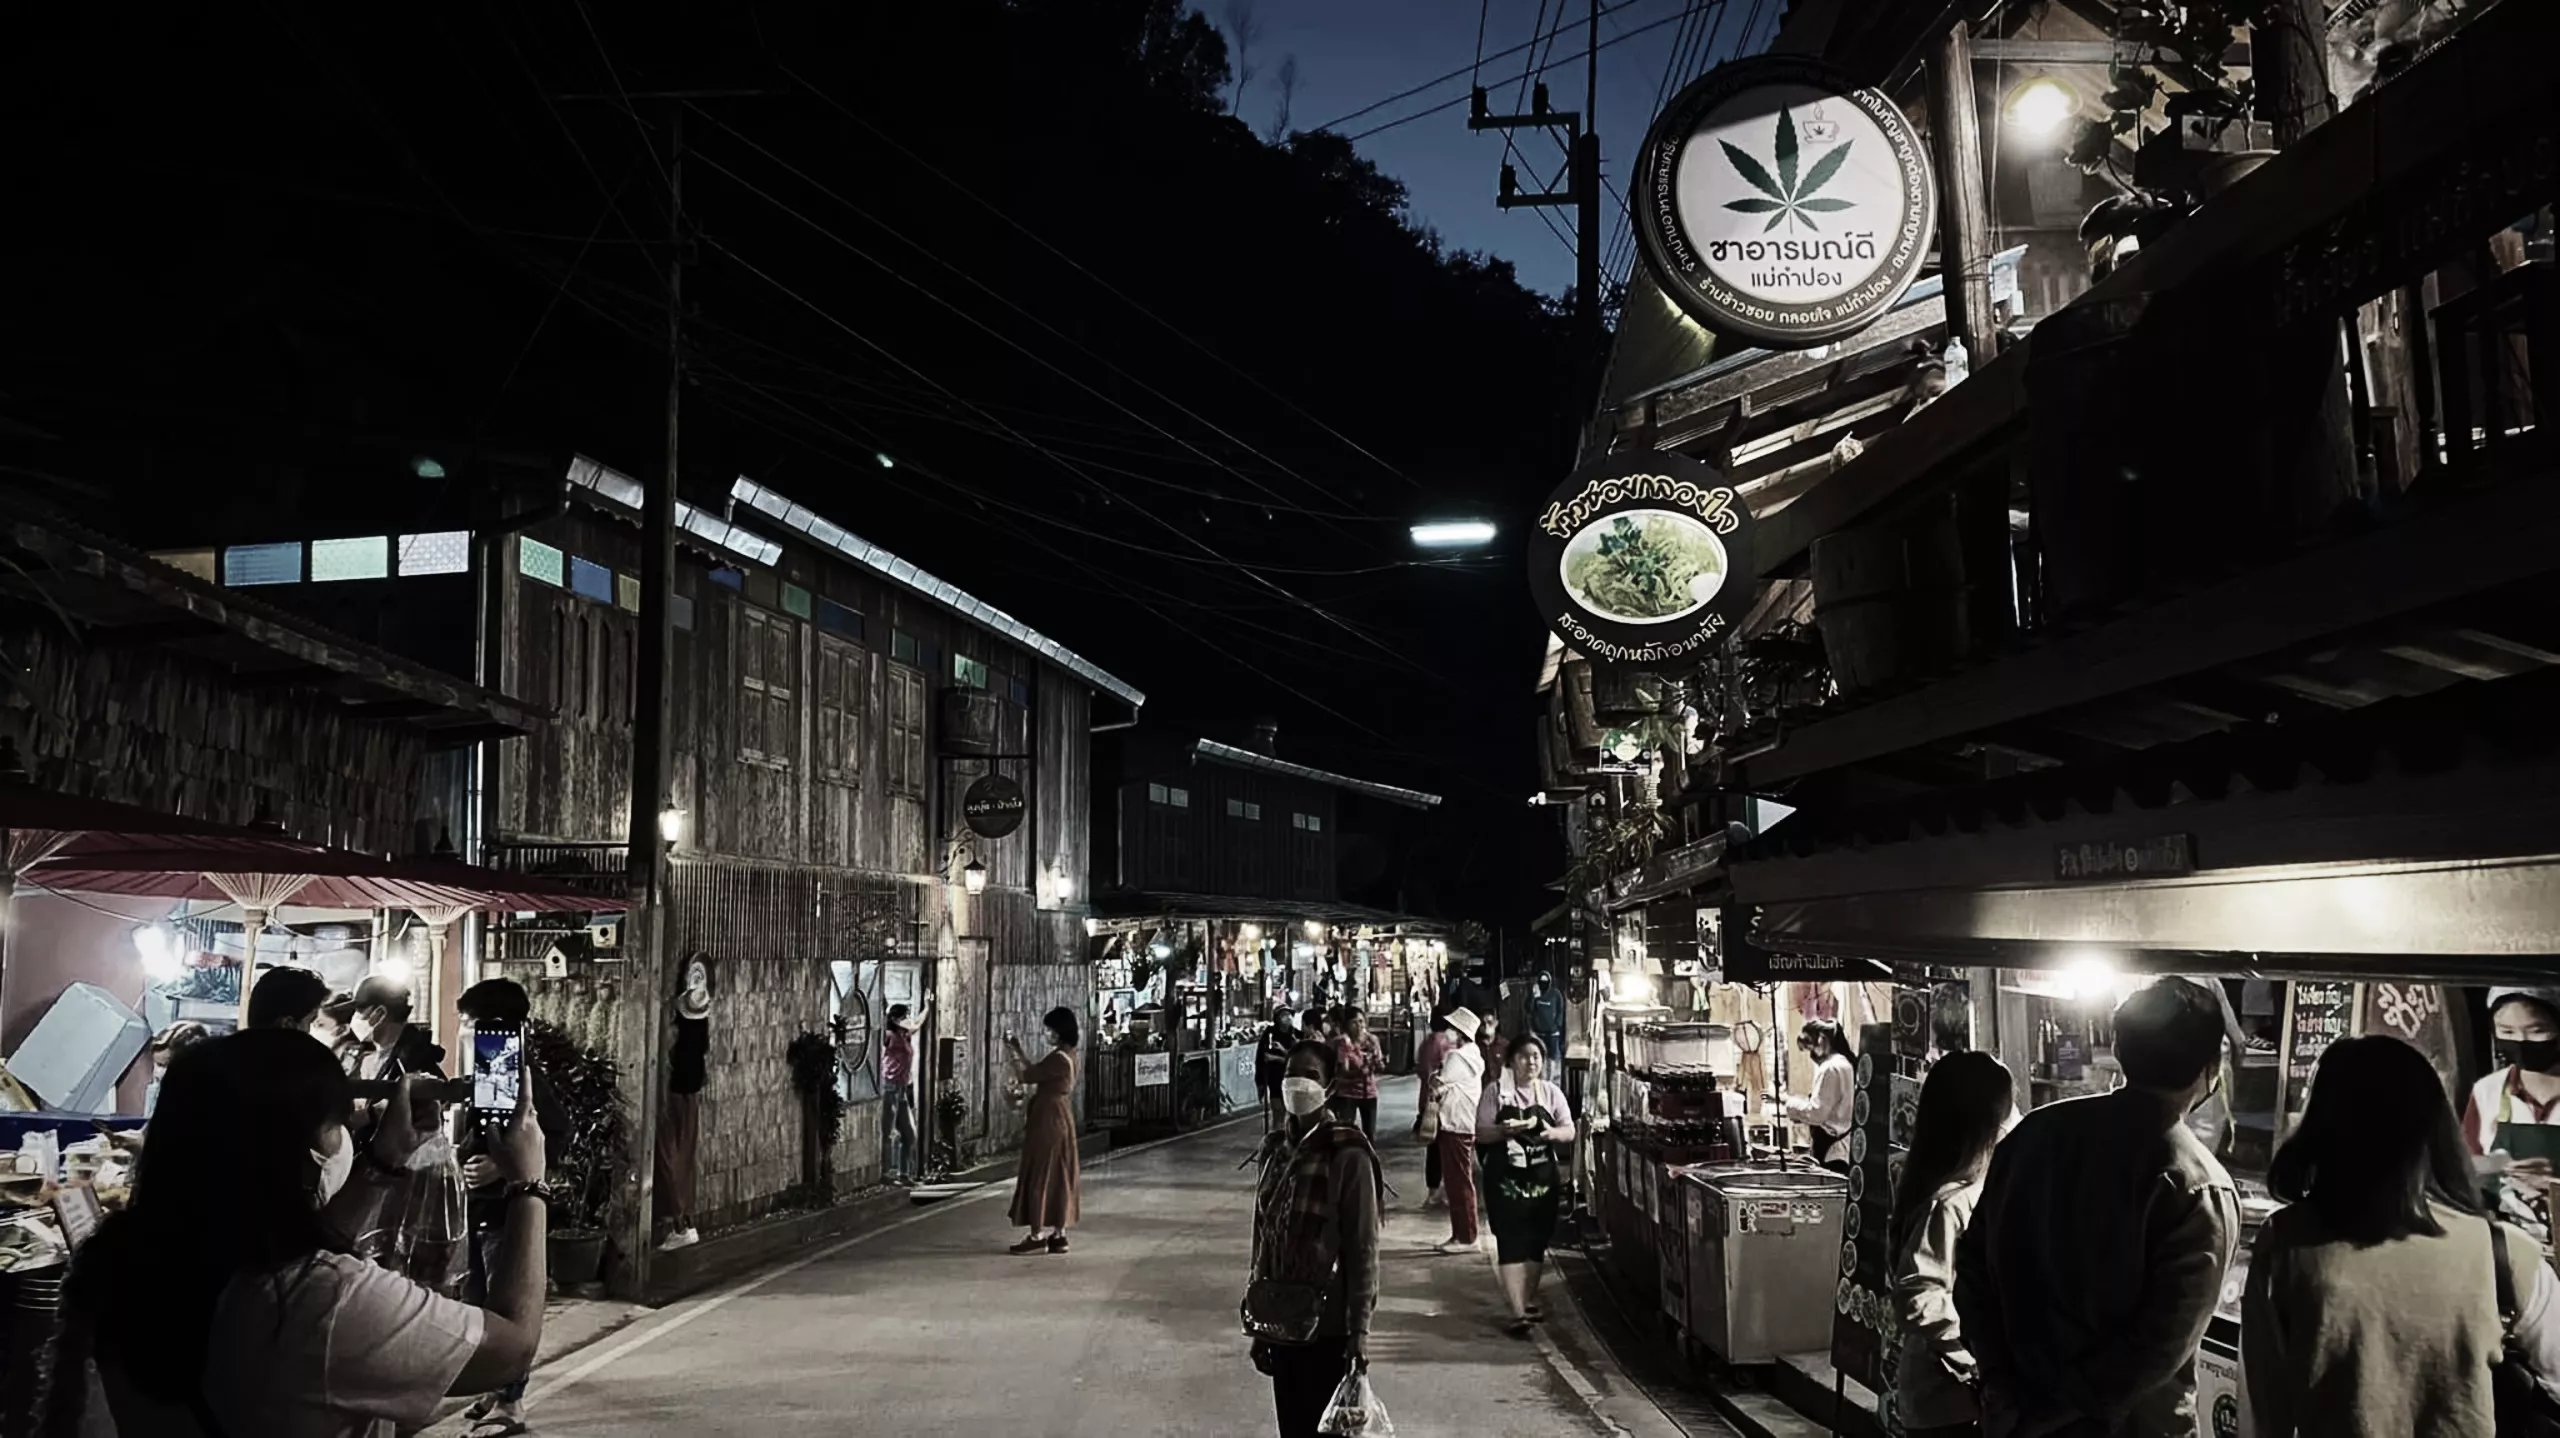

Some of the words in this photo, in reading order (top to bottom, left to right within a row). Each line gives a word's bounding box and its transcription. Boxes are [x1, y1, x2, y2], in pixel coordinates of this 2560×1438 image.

[1709, 231, 1875, 261] ชาอารมณ์ดี
[1751, 267, 1842, 287] แม่กำปอง
[1557, 611, 1726, 664] สะอาดถูกหลักอนามัย
